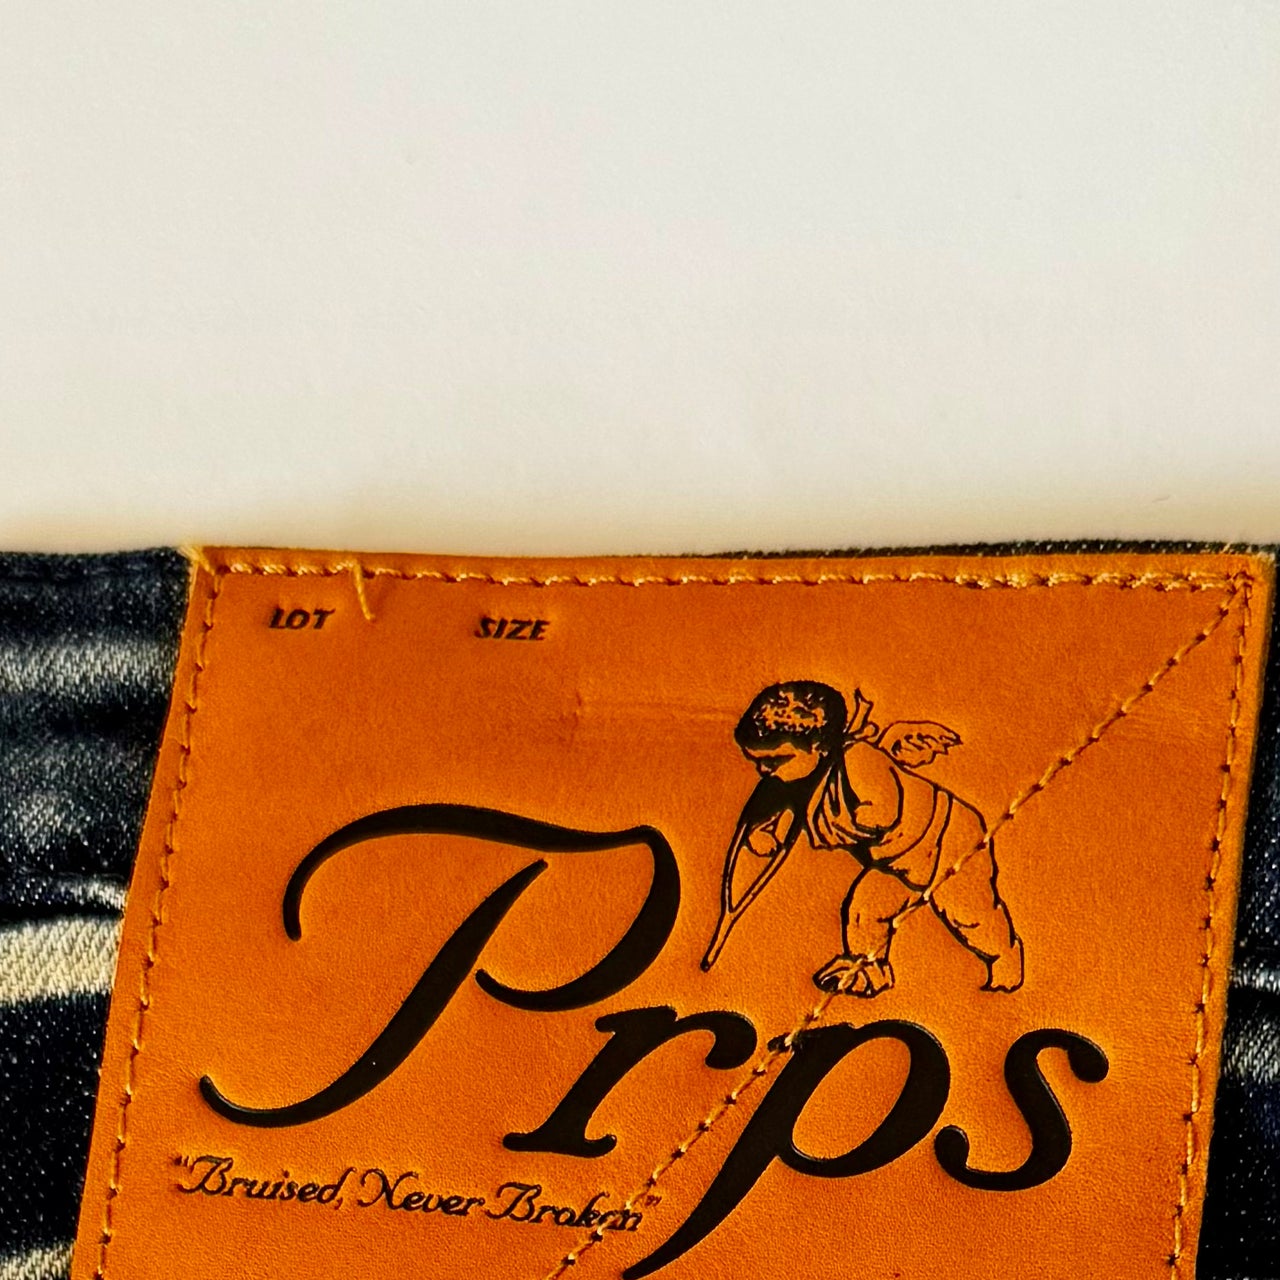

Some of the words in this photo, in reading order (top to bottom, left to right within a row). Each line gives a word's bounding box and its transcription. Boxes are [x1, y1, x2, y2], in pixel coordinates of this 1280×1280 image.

[268, 604, 336, 630] LOT
[474, 615, 550, 641] SIZE
[199, 803, 1109, 1280] Prps
[358, 1168, 486, 1217] Never
